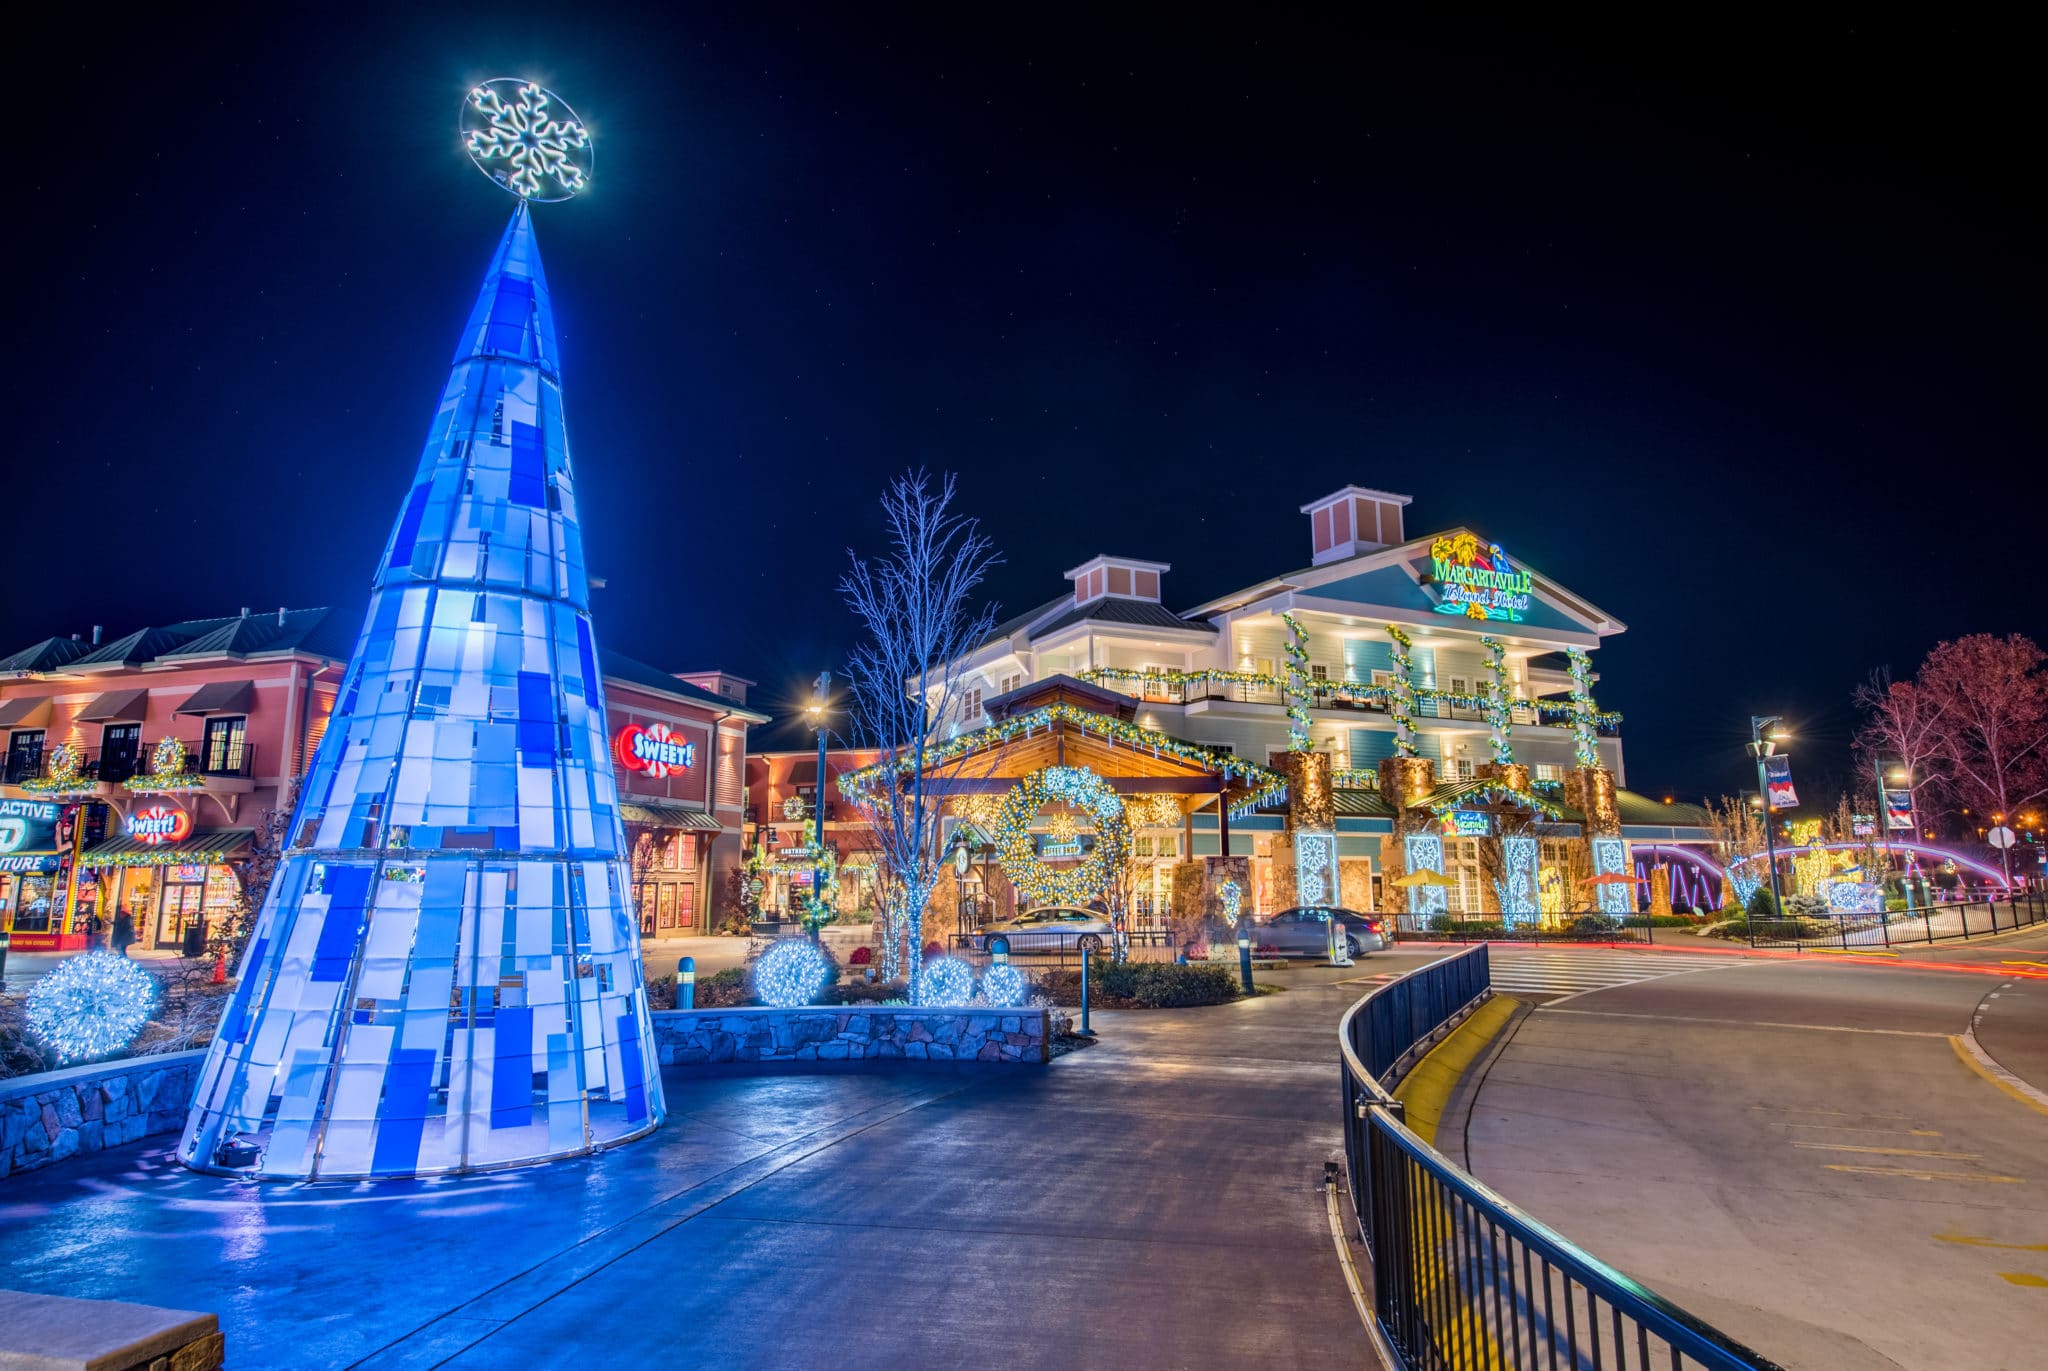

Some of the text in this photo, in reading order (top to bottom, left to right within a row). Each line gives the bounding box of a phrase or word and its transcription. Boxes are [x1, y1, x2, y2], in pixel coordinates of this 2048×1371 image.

[1433, 557, 1533, 594] MARGARITAVILLE
[1442, 583, 1529, 610] Island Hotel
[633, 731, 694, 768] SWEET!
[0, 801, 55, 819] ACTIVE
[127, 815, 176, 835] SWEET!
